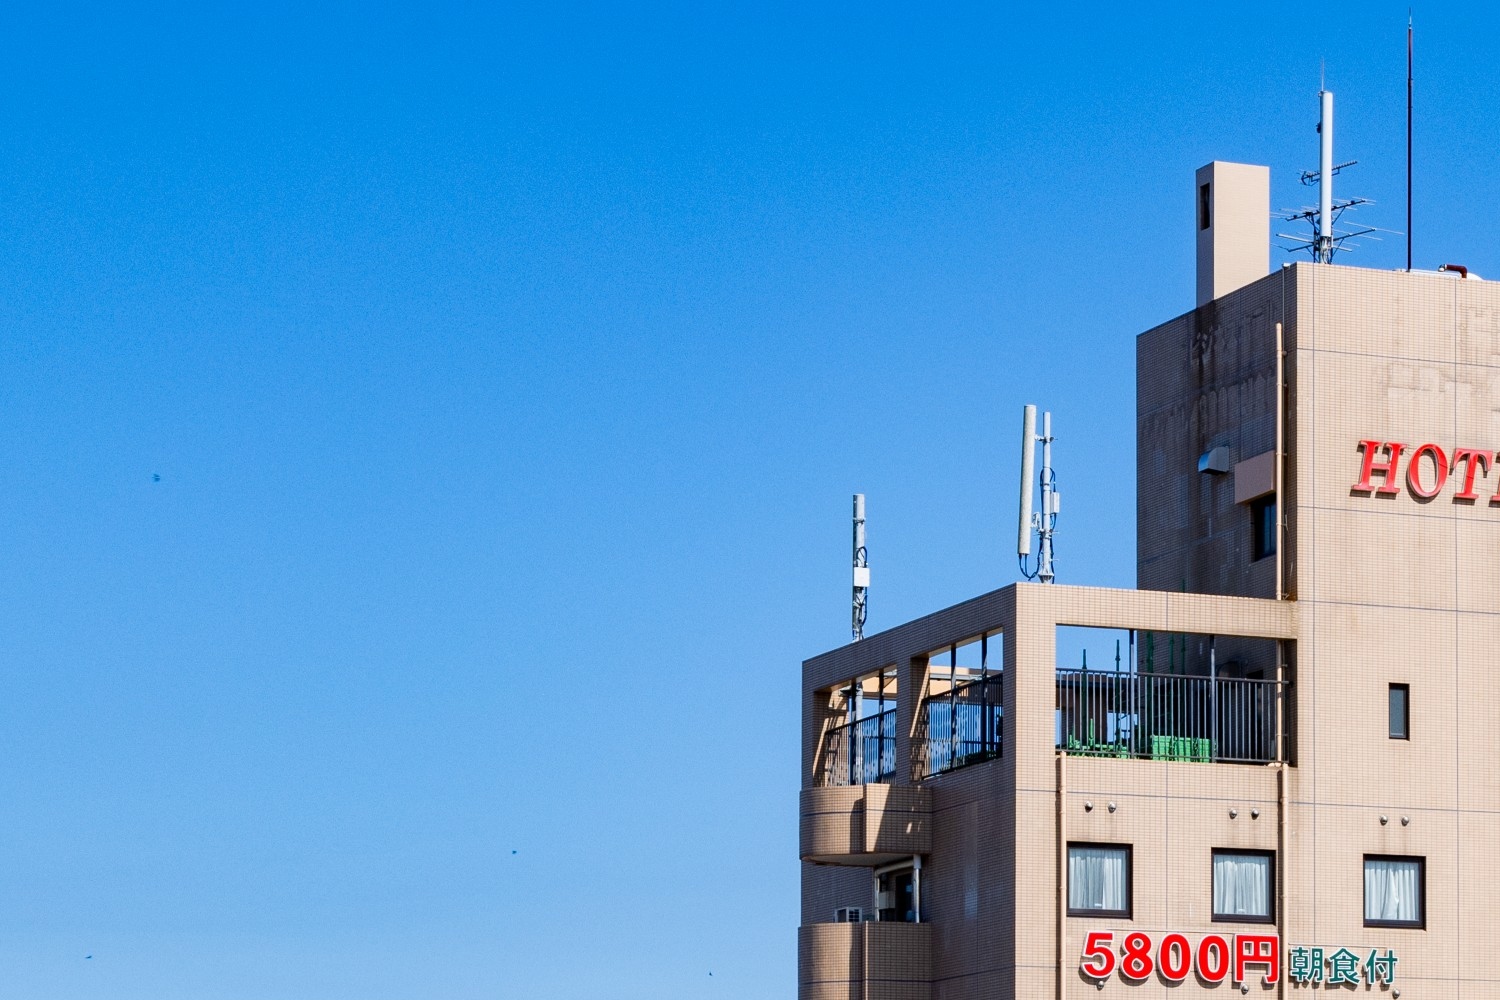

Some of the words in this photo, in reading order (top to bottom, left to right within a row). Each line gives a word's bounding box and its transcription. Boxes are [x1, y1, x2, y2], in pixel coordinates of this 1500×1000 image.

[1082, 931, 1280, 983] 5800円
[1290, 947, 1399, 985] 朝食付
